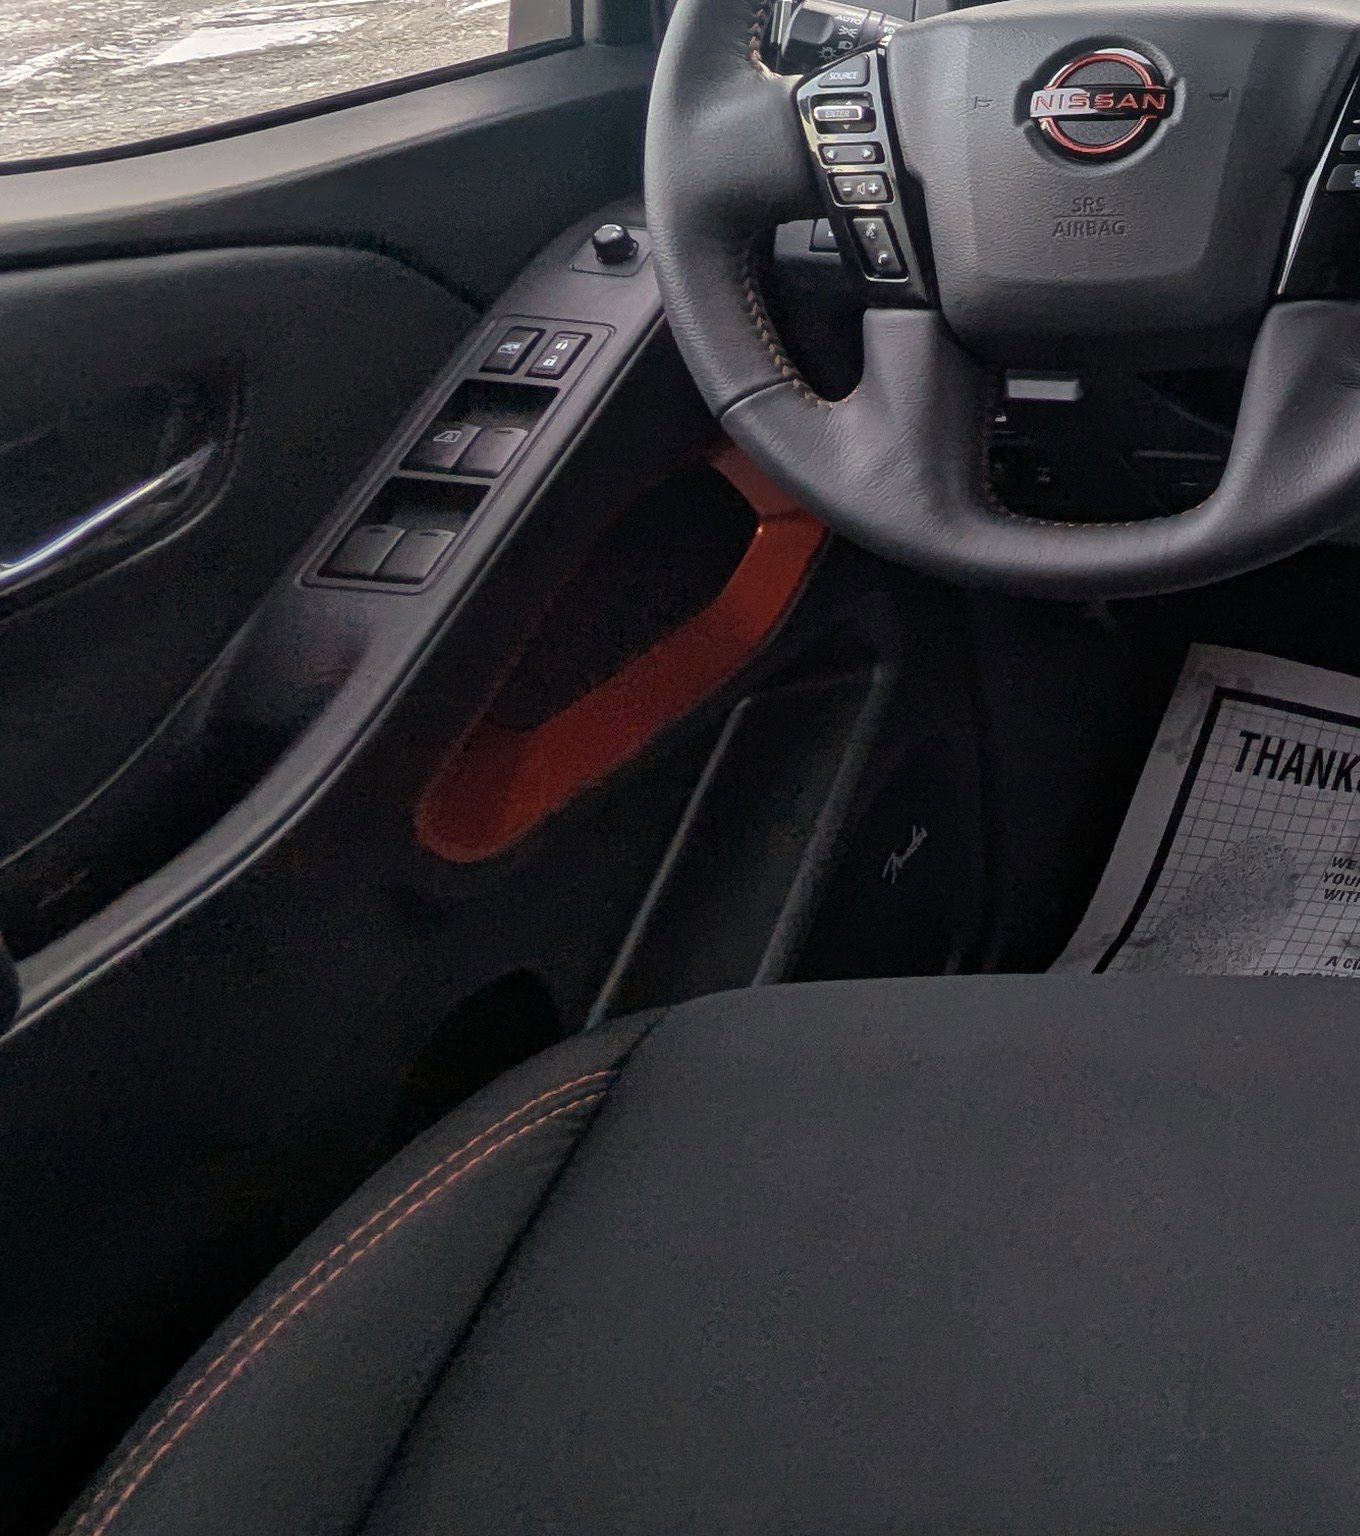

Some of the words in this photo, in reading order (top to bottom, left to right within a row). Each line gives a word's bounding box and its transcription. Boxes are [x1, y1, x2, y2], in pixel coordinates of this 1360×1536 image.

[835, 14, 862, 25] AUTO
[829, 72, 858, 80] SOURCE
[1035, 92, 1167, 111] NISSAN
[1071, 196, 1106, 215] SRS
[1052, 219, 1126, 238] AIRBAG
[1332, 857, 1358, 870] WE
[1325, 955, 1339, 967] A
